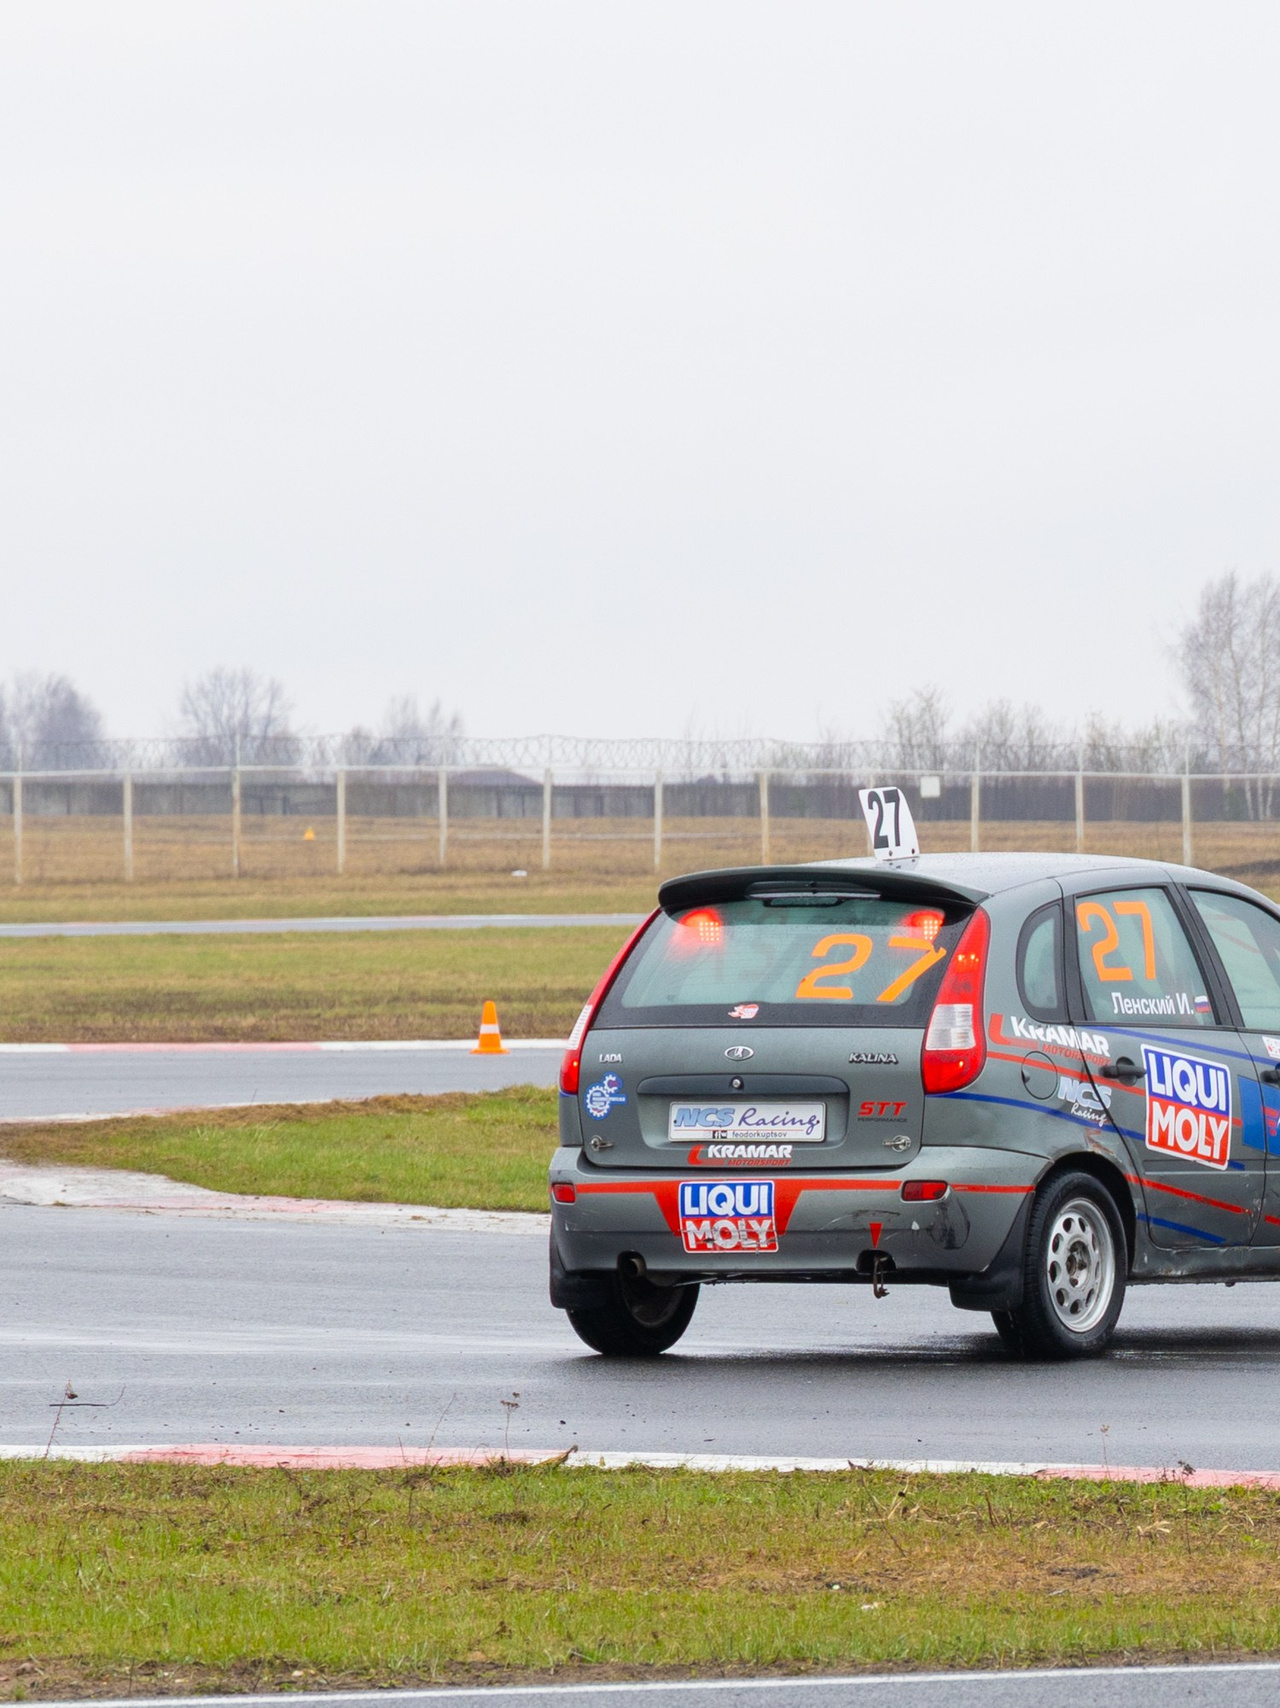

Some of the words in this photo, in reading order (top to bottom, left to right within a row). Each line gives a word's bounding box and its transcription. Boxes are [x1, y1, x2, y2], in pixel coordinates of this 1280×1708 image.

[868, 789, 901, 849] 27
[1076, 901, 1156, 981] 27
[795, 933, 947, 1002] 27
[1111, 992, 1175, 1014] Ленский
[1175, 993, 1194, 1014] И.
[1010, 1016, 1111, 1057] KRAMAR
[599, 1053, 622, 1064] LADA
[849, 1052, 898, 1065] KALINA
[1042, 1044, 1111, 1067] MOTORSPORT
[1057, 1076, 1112, 1111] NCS
[1148, 1052, 1227, 1112] LIQUI
[674, 1107, 735, 1128] NCS
[737, 1107, 818, 1136] Racing
[858, 1101, 908, 1116] STT
[1070, 1102, 1107, 1127] Racing
[731, 1130, 788, 1140] feodorkuptsov
[1151, 1100, 1228, 1160] MOLY
[707, 1144, 793, 1159] KRAMAR
[727, 1158, 792, 1167] MOTORSPORT
[684, 1184, 769, 1217] LIQUI
[685, 1219, 772, 1249] MOLY
